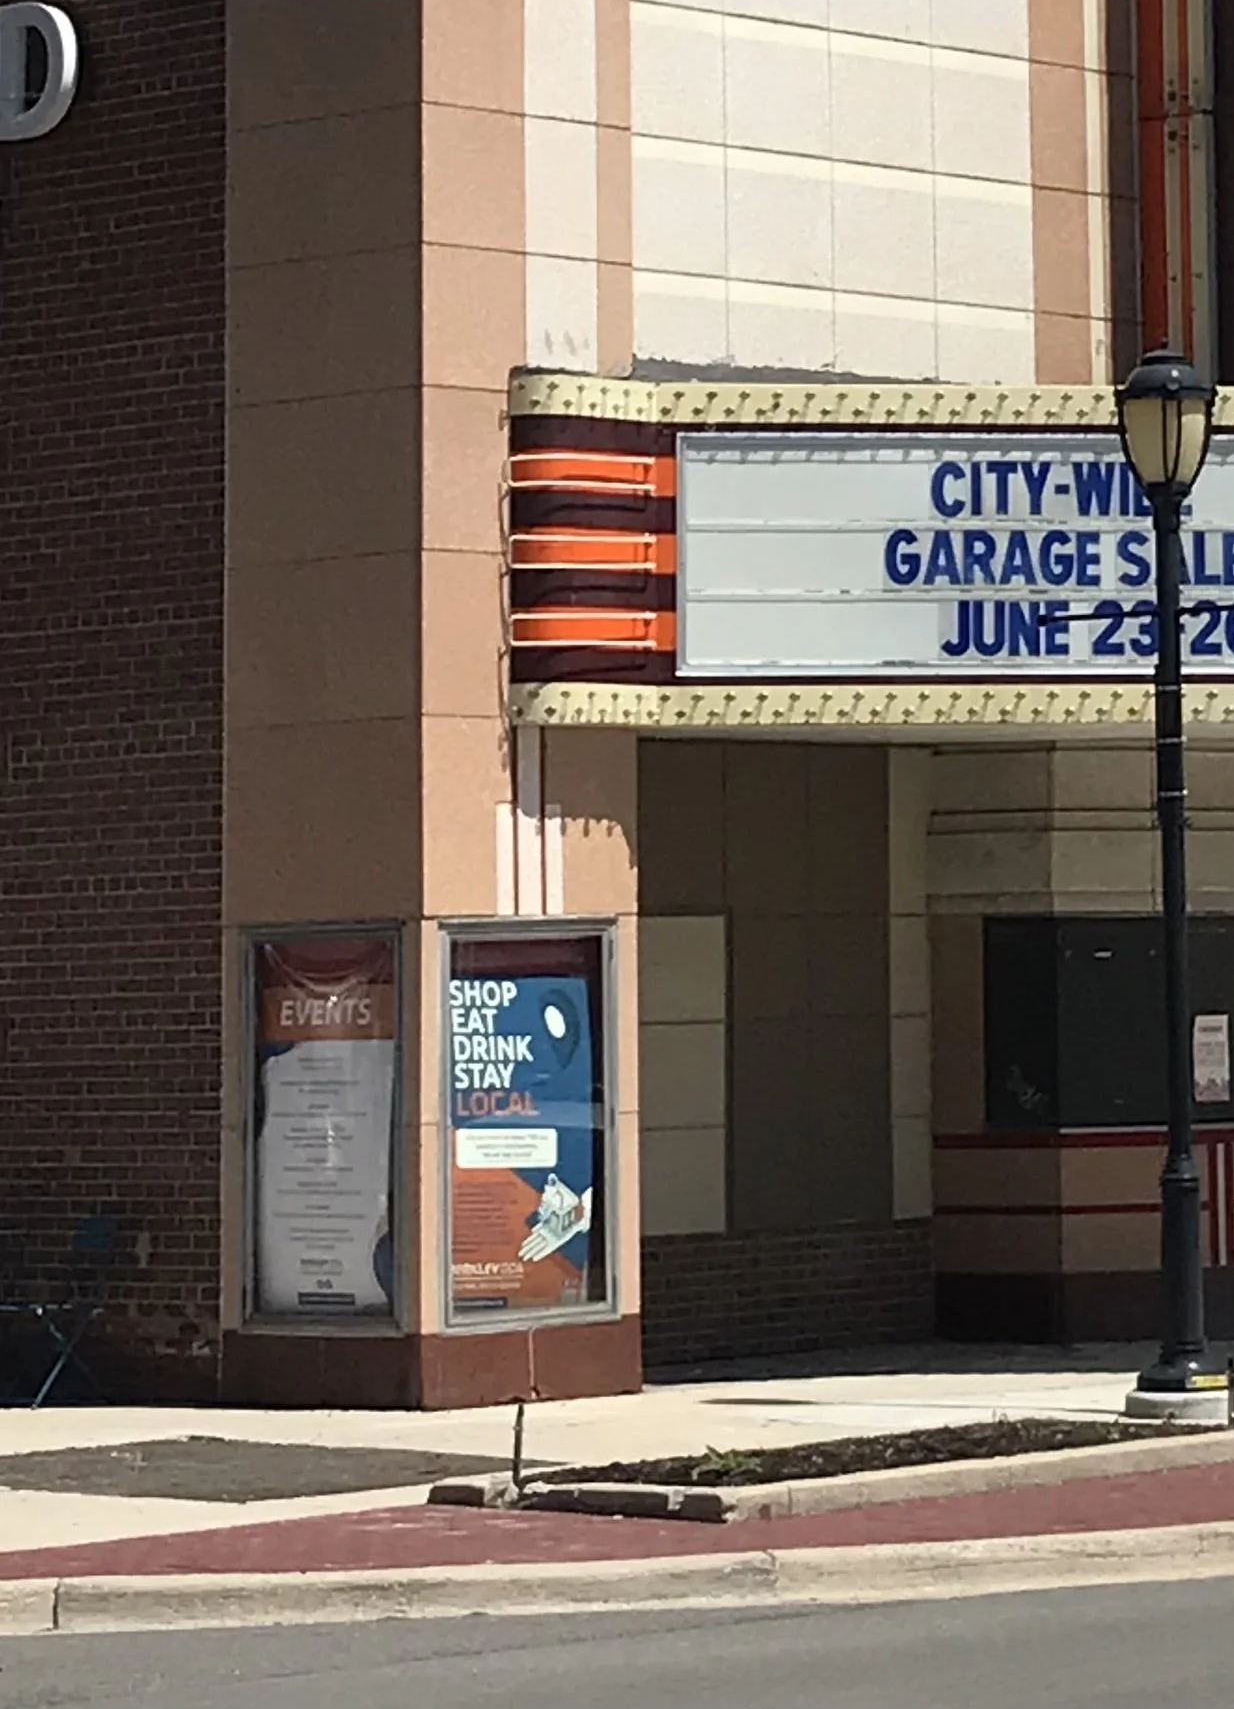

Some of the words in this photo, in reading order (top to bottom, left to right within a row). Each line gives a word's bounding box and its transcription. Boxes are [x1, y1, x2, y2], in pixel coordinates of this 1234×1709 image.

[931, 460, 1192, 518] CITY-WI
[884, 528, 1101, 587] GARAGE
[940, 599, 1070, 657] JUNE
[449, 979, 518, 1007] SHOP
[280, 997, 372, 1027] EVENTS
[451, 1007, 498, 1034] EAT
[453, 1034, 534, 1062] DRINK
[454, 1062, 516, 1089] STAY
[456, 1091, 539, 1117] LOCAL
